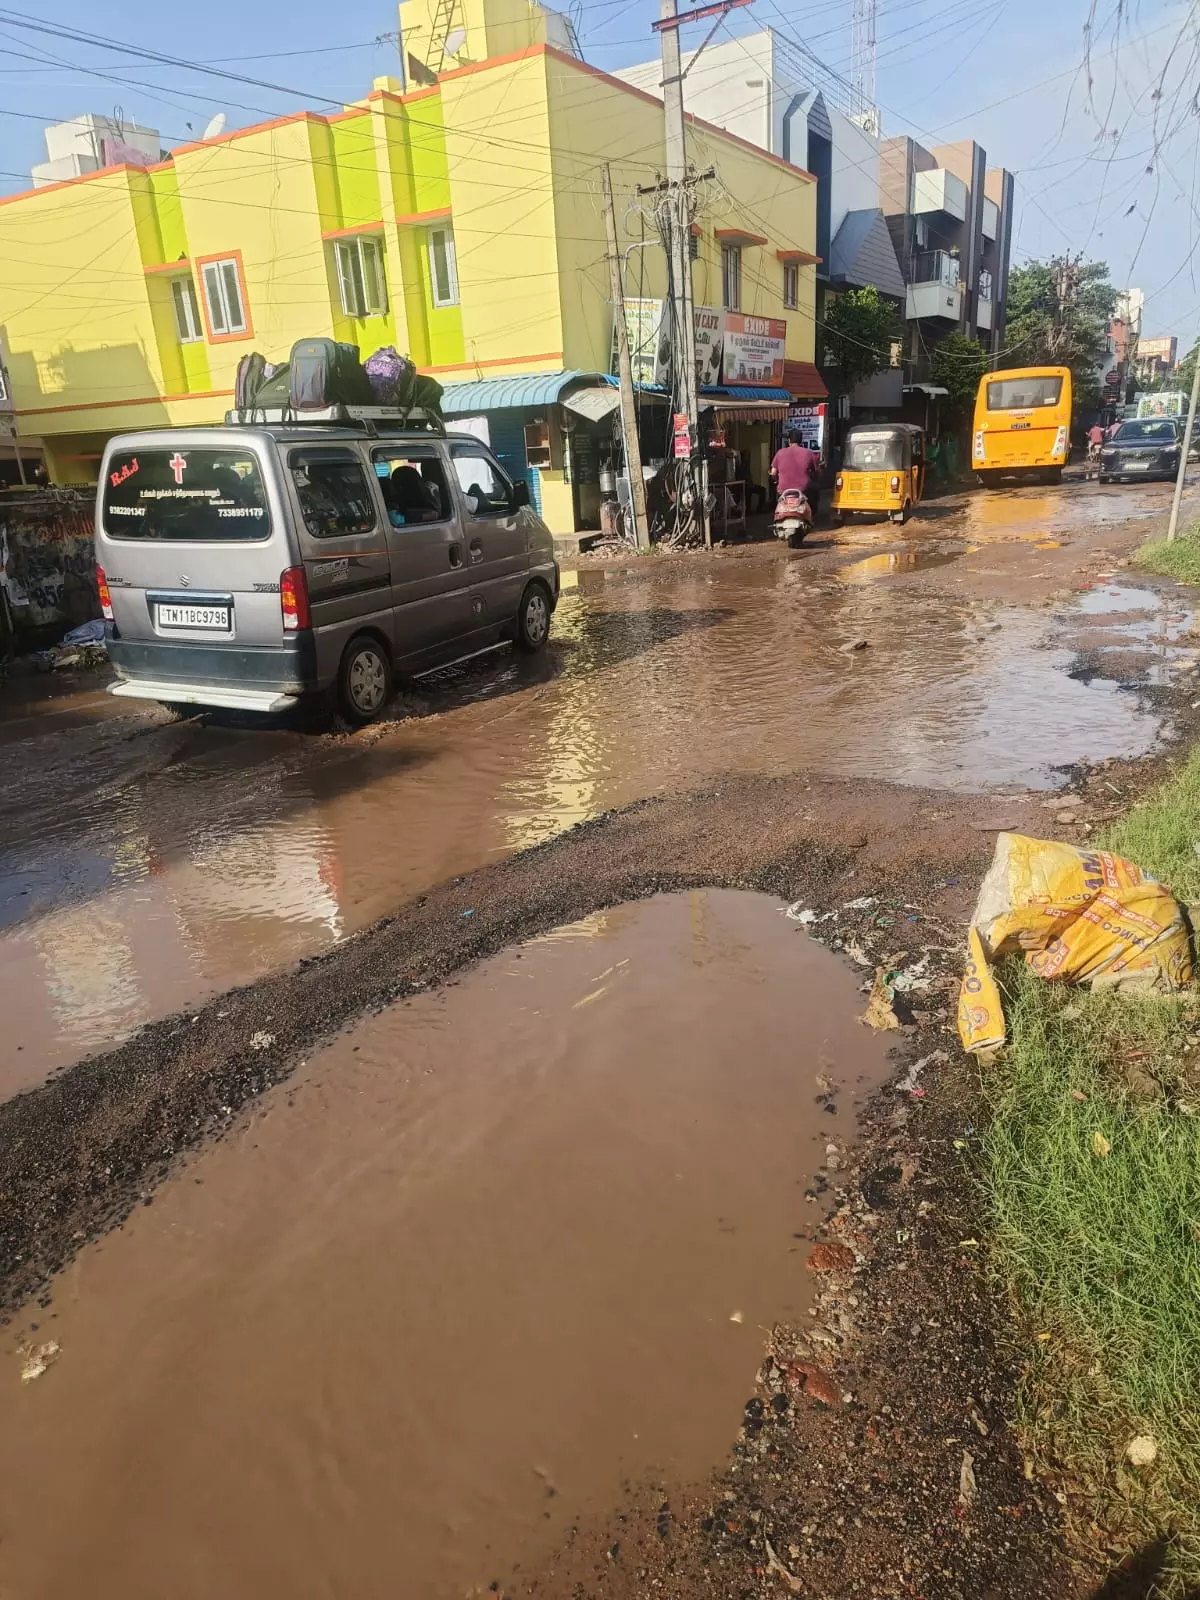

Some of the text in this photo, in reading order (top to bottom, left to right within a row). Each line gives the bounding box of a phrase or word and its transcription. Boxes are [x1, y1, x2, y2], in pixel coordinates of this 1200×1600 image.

[702, 314, 719, 330] CAFE
[744, 317, 770, 336] EXIDE
[788, 407, 819, 416] EXIDE
[110, 457, 139, 487] R.A.J
[166, 608, 227, 624] TN11BC9796
